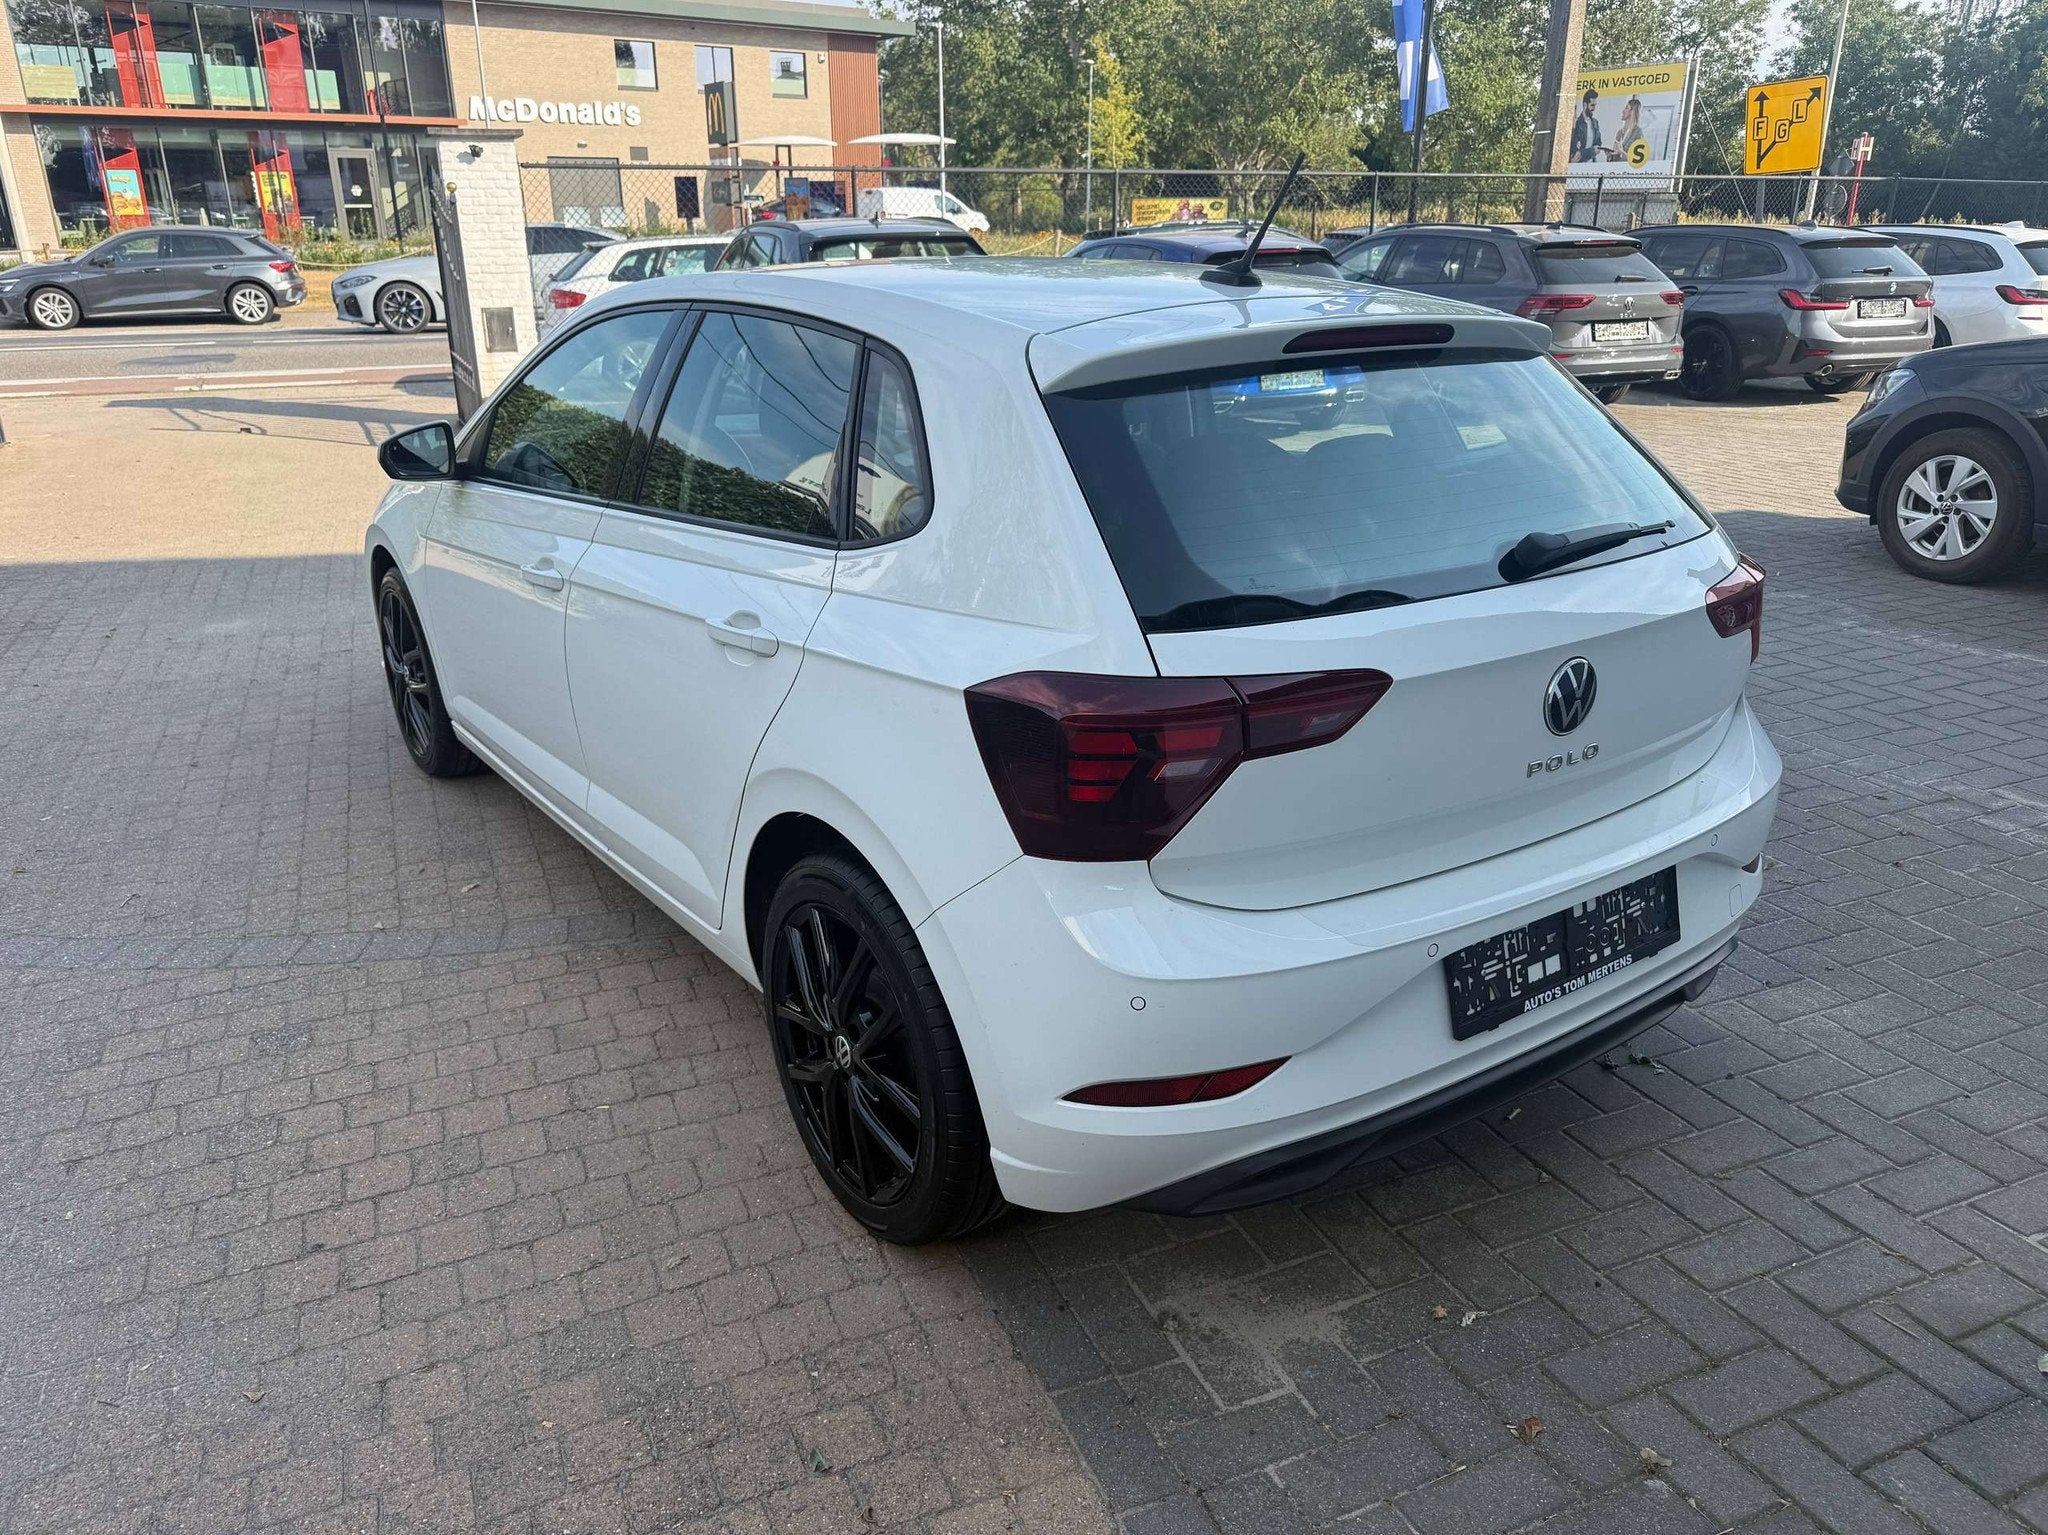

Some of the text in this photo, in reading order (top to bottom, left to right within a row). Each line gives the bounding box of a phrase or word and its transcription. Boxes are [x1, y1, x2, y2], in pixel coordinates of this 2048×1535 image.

[1576, 73, 1670, 91] ERK IN VASTGOED
[469, 96, 641, 127] McDonald's
[1796, 103, 1804, 119] L
[1756, 121, 1765, 137] F
[1778, 122, 1787, 139] G
[1631, 144, 1645, 163] S
[1527, 742, 1599, 778] POLO
[1523, 954, 1633, 1012] AUTO'S TOM MERTENS
